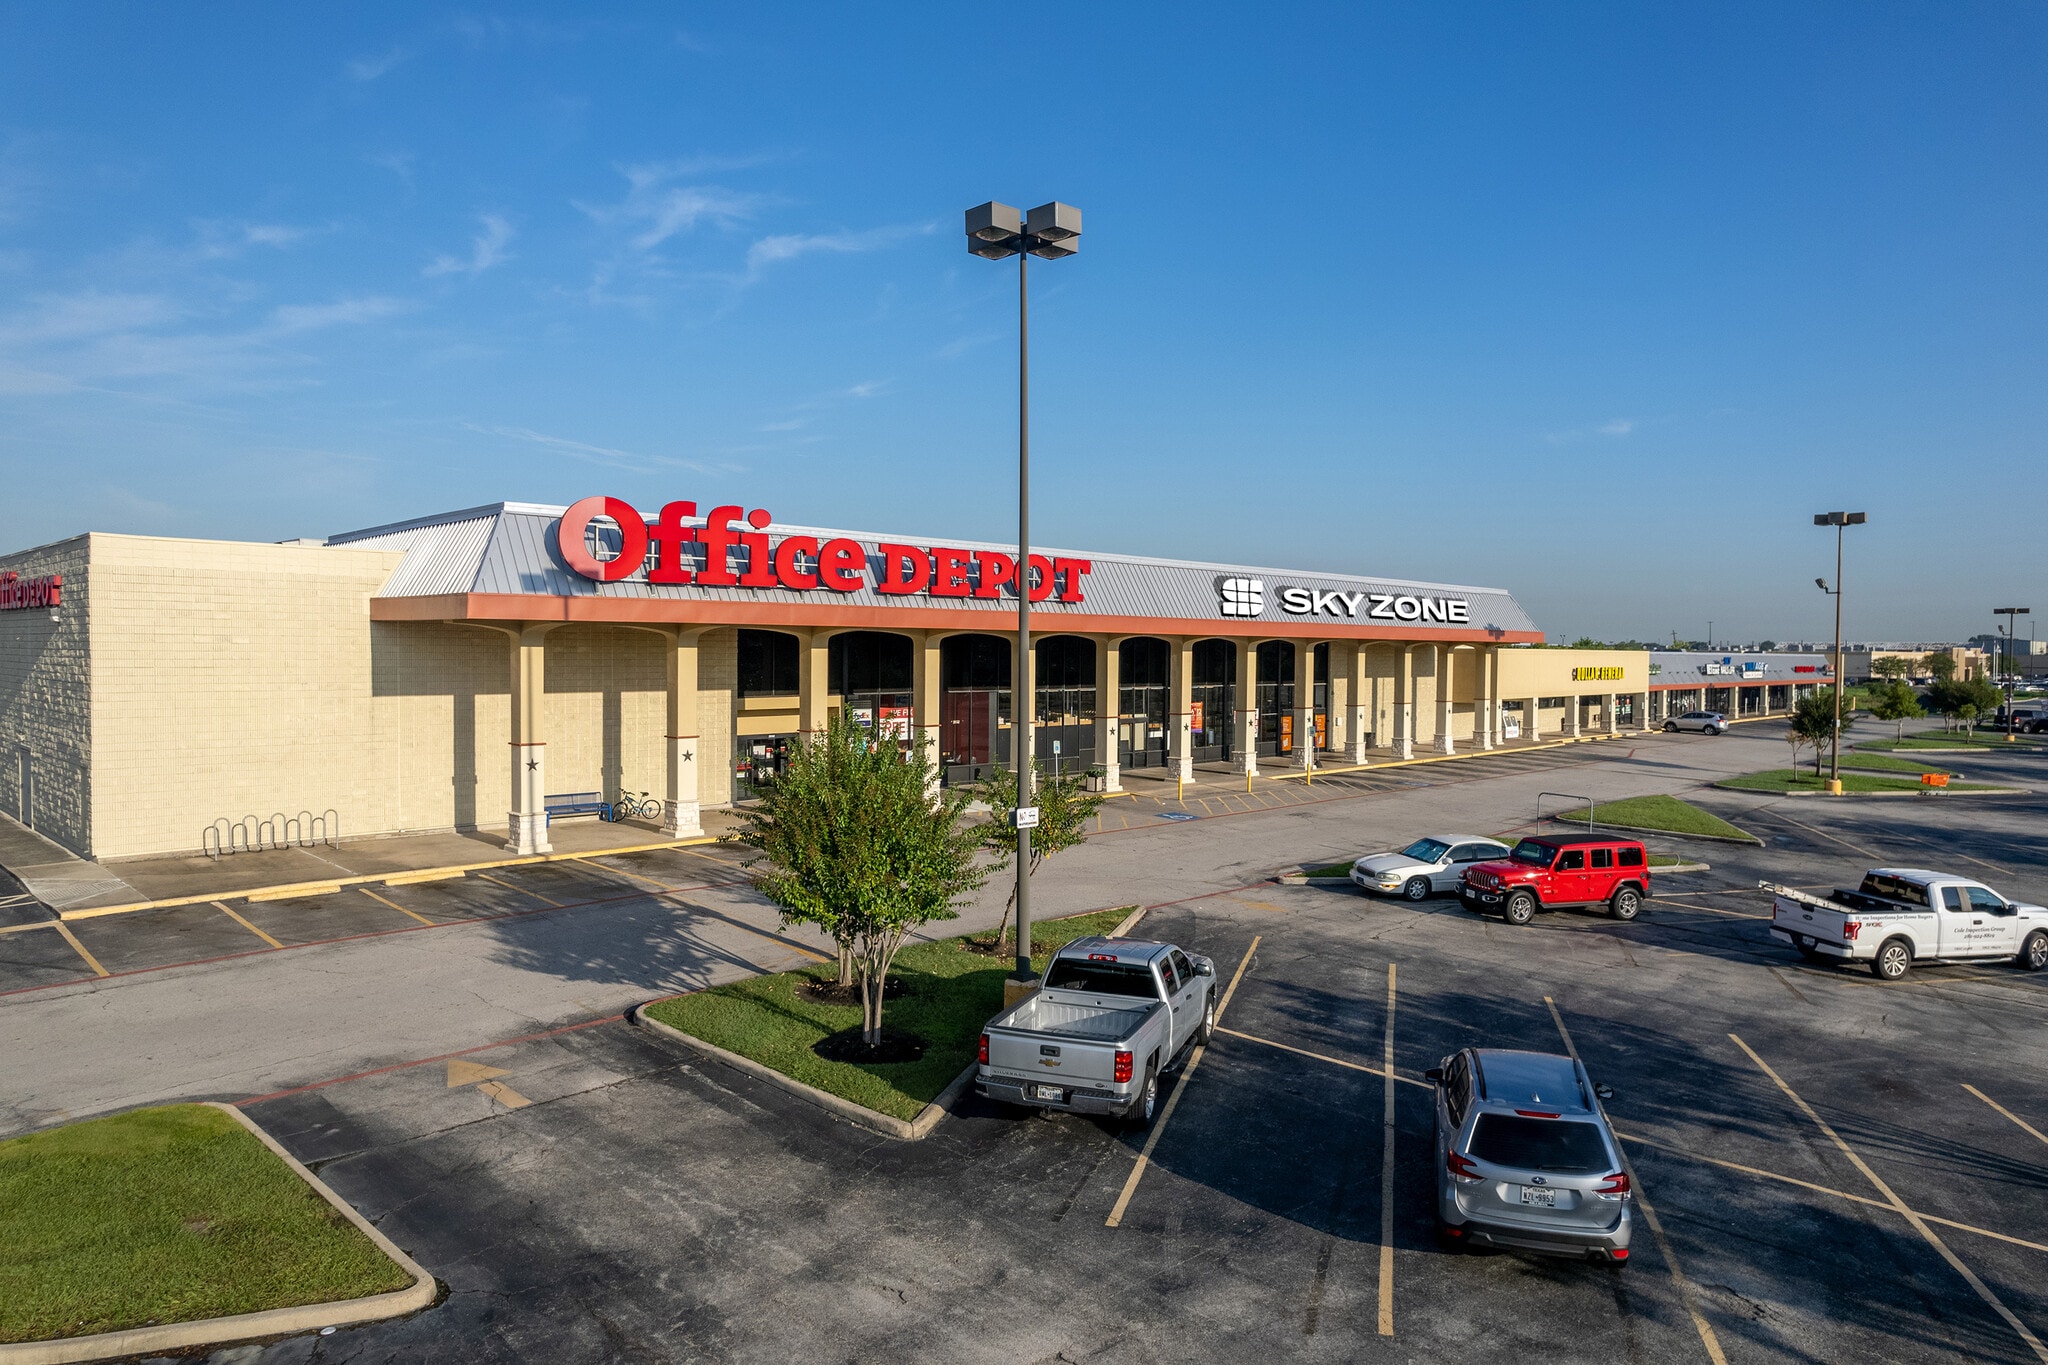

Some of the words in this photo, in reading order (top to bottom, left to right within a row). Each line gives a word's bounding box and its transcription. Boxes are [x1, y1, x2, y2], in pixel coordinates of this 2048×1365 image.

[558, 495, 866, 593] Office
[878, 542, 1092, 603] DEPOT
[22, 574, 62, 607] DEPOT
[1282, 588, 1365, 617] SKY
[1369, 594, 1470, 622] ZONE
